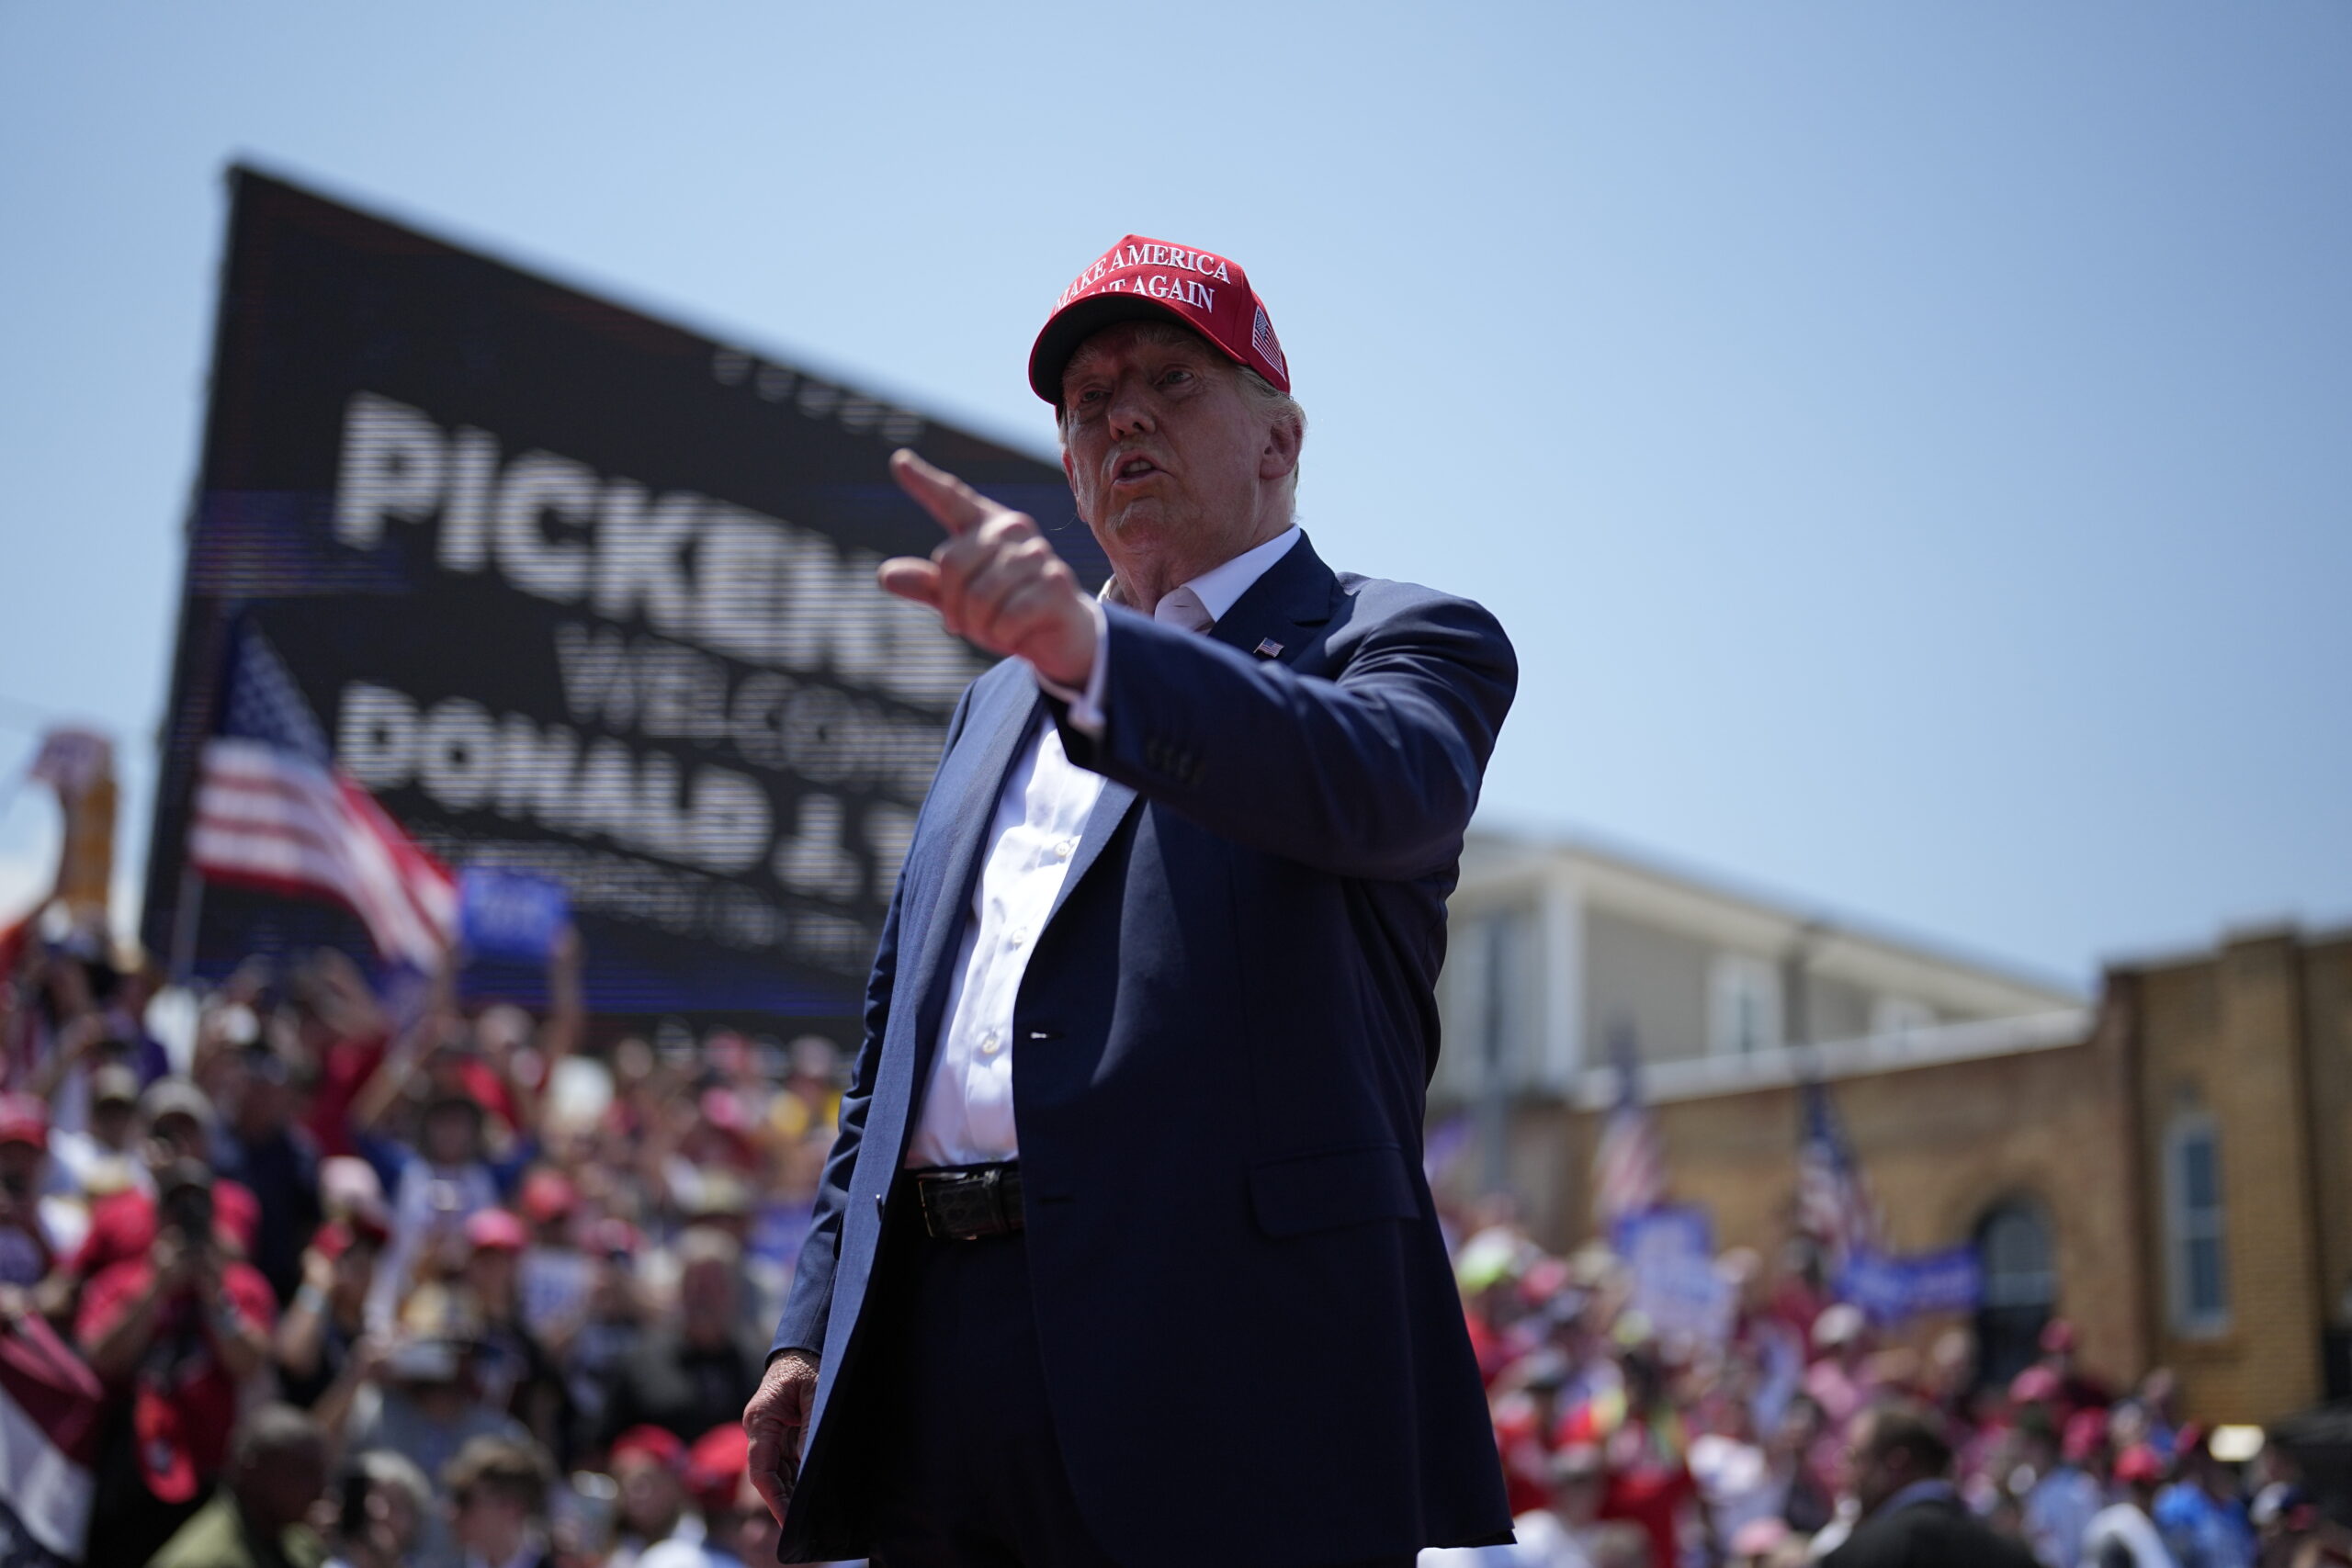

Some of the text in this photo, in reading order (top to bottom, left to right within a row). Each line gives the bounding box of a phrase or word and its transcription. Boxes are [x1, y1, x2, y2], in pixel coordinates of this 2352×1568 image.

[1054, 243, 1231, 311] MAKE AMERICA
[1133, 275, 1215, 313] AGAIN
[336, 682, 774, 875] DONALD
